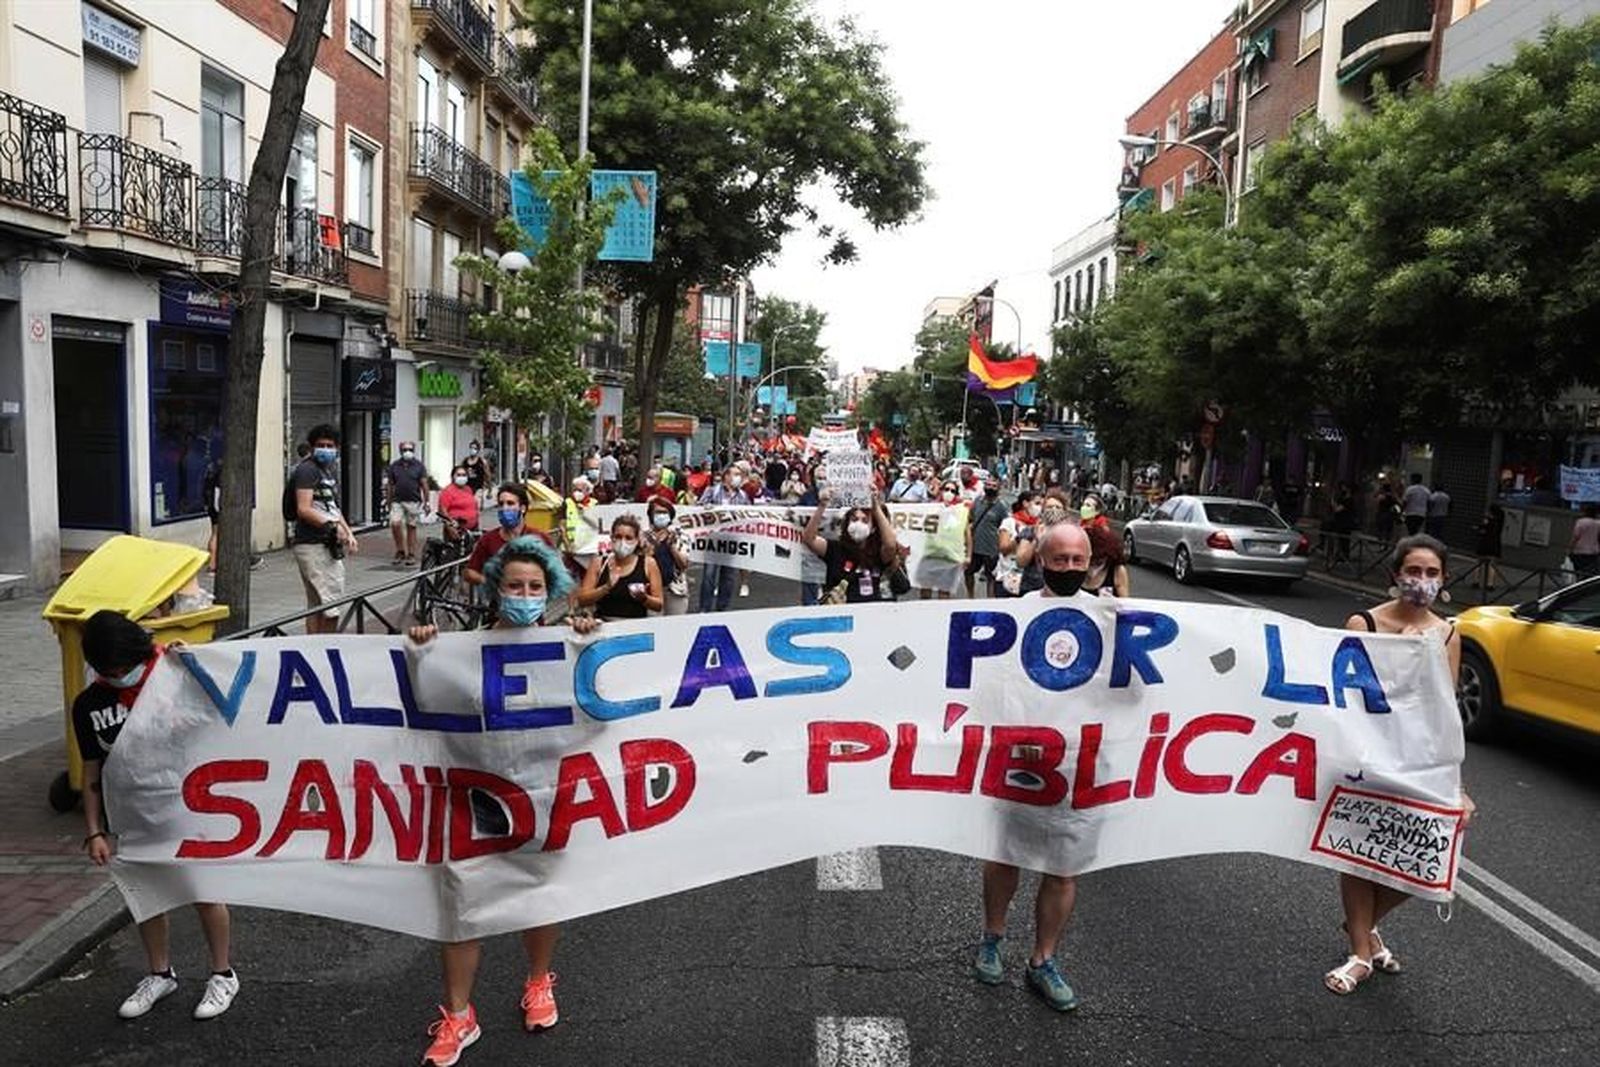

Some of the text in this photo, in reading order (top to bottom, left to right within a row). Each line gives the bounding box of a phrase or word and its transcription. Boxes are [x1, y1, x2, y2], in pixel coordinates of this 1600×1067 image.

[179, 606, 1393, 733] VALLECAS POR LA
[90, 703, 128, 731] MA
[175, 702, 1317, 864] SANIDAD PÚBLICA
[1329, 810, 1352, 822] POR
[1370, 818, 1450, 853] SANIDAD
[1333, 796, 1441, 833] PLATAFORMA
[1328, 834, 1440, 881] VALLEKAS
